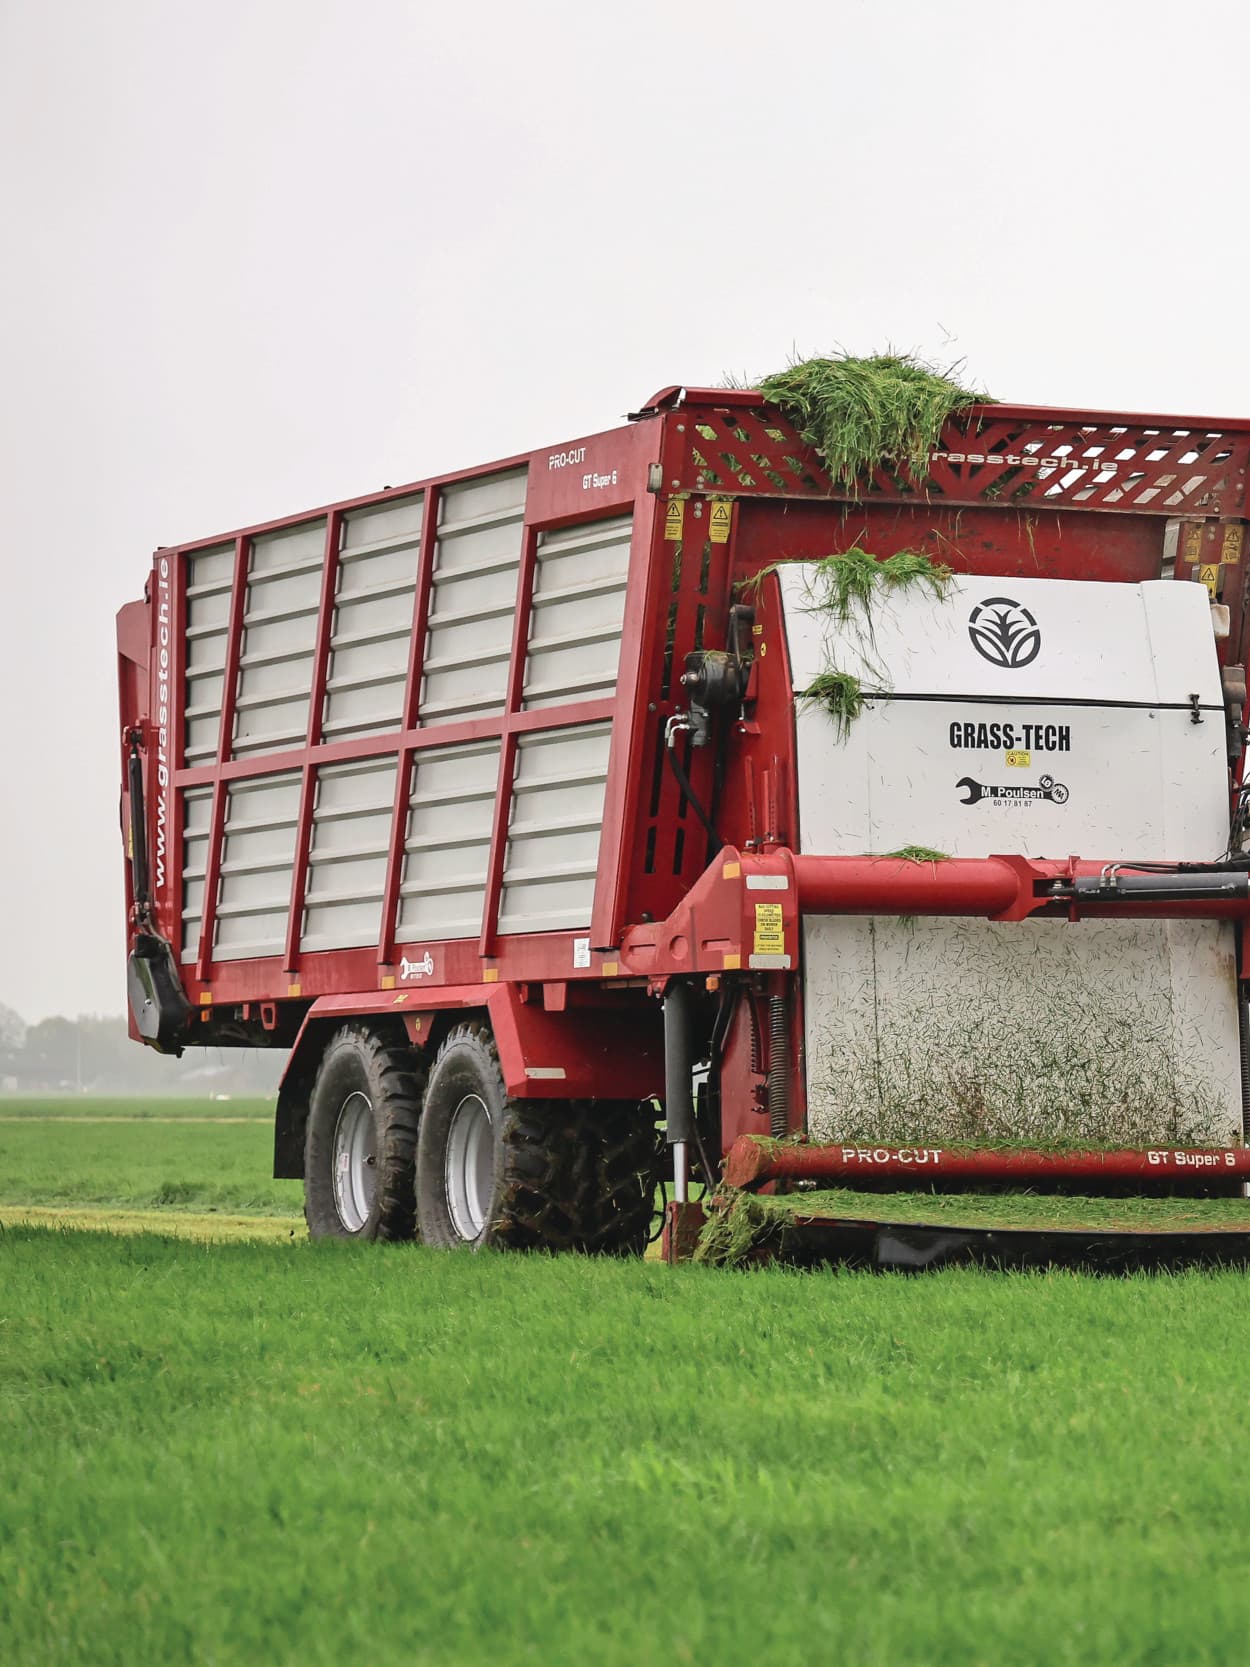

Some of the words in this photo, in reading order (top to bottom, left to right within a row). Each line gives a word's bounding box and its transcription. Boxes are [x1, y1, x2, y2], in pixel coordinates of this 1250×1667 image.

[548, 447, 587, 471] PRO-CUT
[582, 474, 593, 490] GT
[593, 472, 611, 489] Super
[612, 470, 617, 485] 6
[156, 558, 169, 888] www.grasstech.ie
[949, 721, 1071, 752] GRASS-TECH
[981, 786, 994, 798] M.
[997, 787, 1044, 799] Poulsen
[842, 1148, 942, 1164] PRO-CUT
[1147, 1151, 1169, 1165] GT
[1174, 1151, 1220, 1169] Super
[1224, 1152, 1236, 1167] 6
